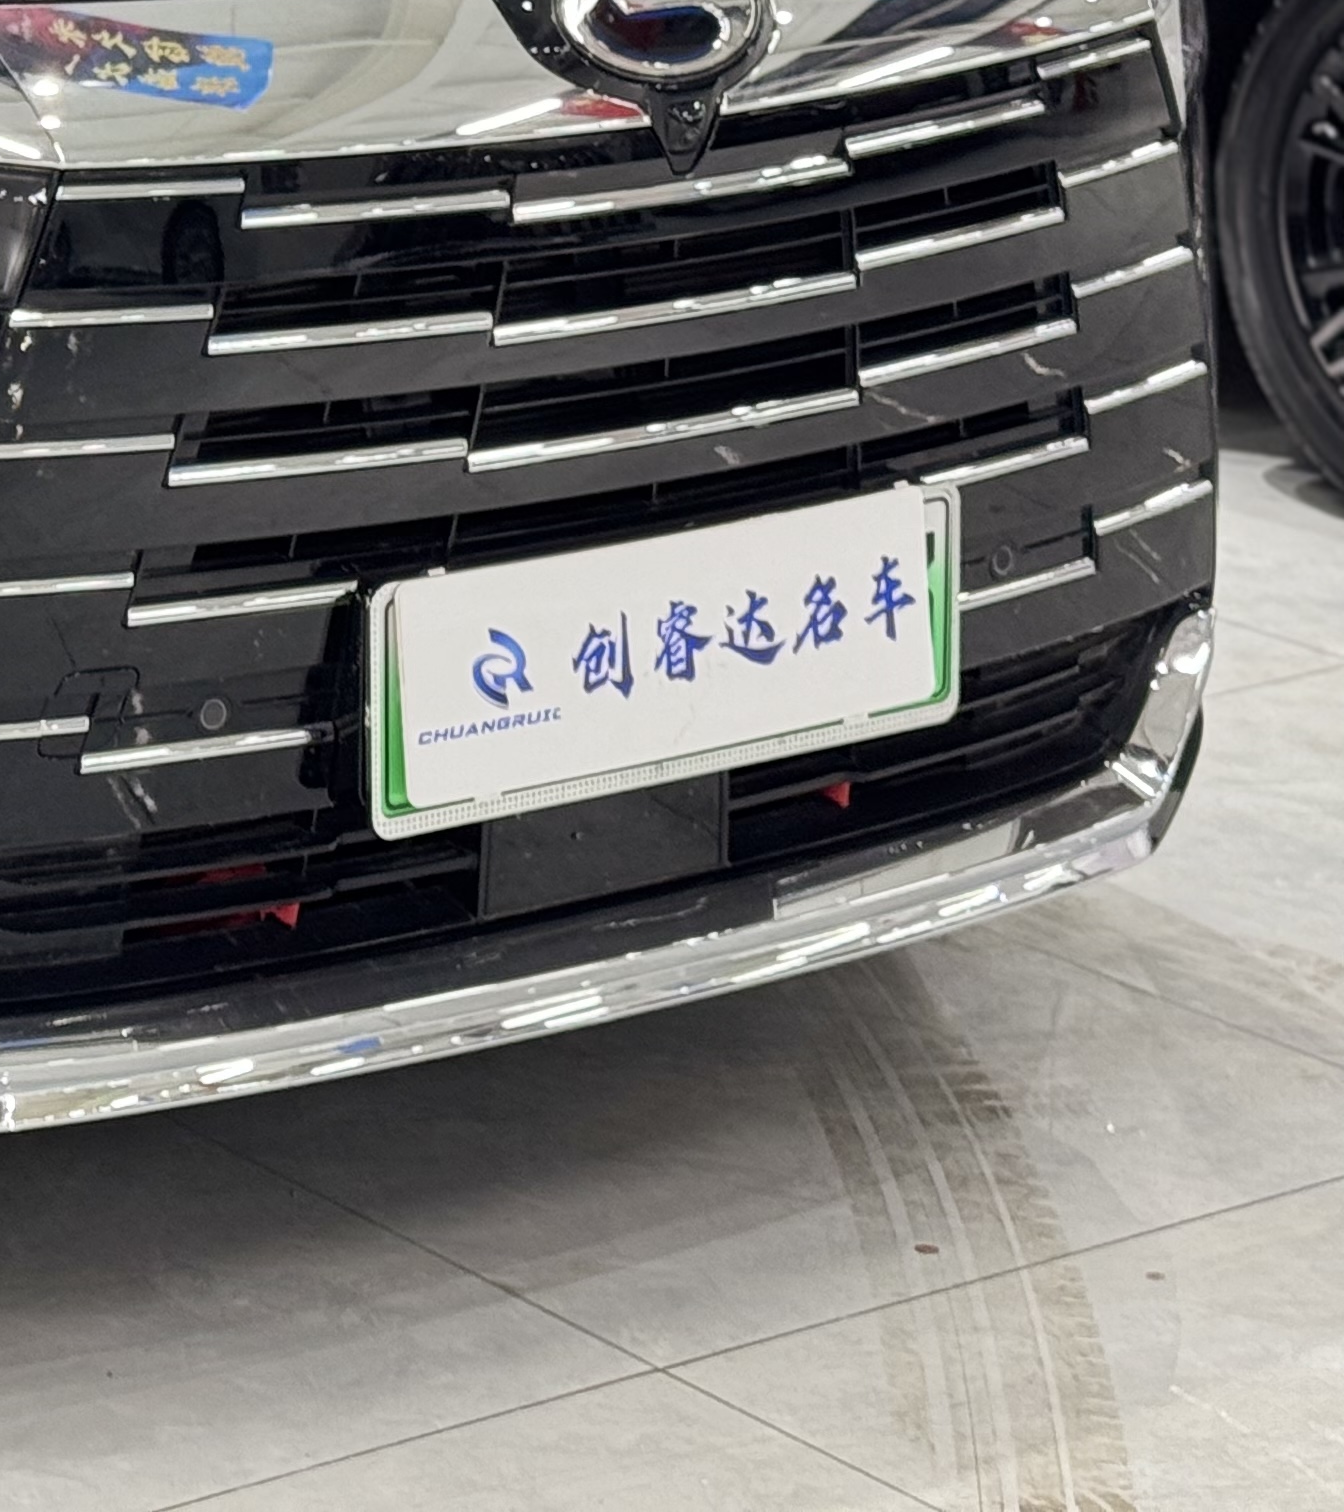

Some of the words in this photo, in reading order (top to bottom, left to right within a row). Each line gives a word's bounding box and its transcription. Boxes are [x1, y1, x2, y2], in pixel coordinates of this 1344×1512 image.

[572, 556, 916, 698] 创睿达名车
